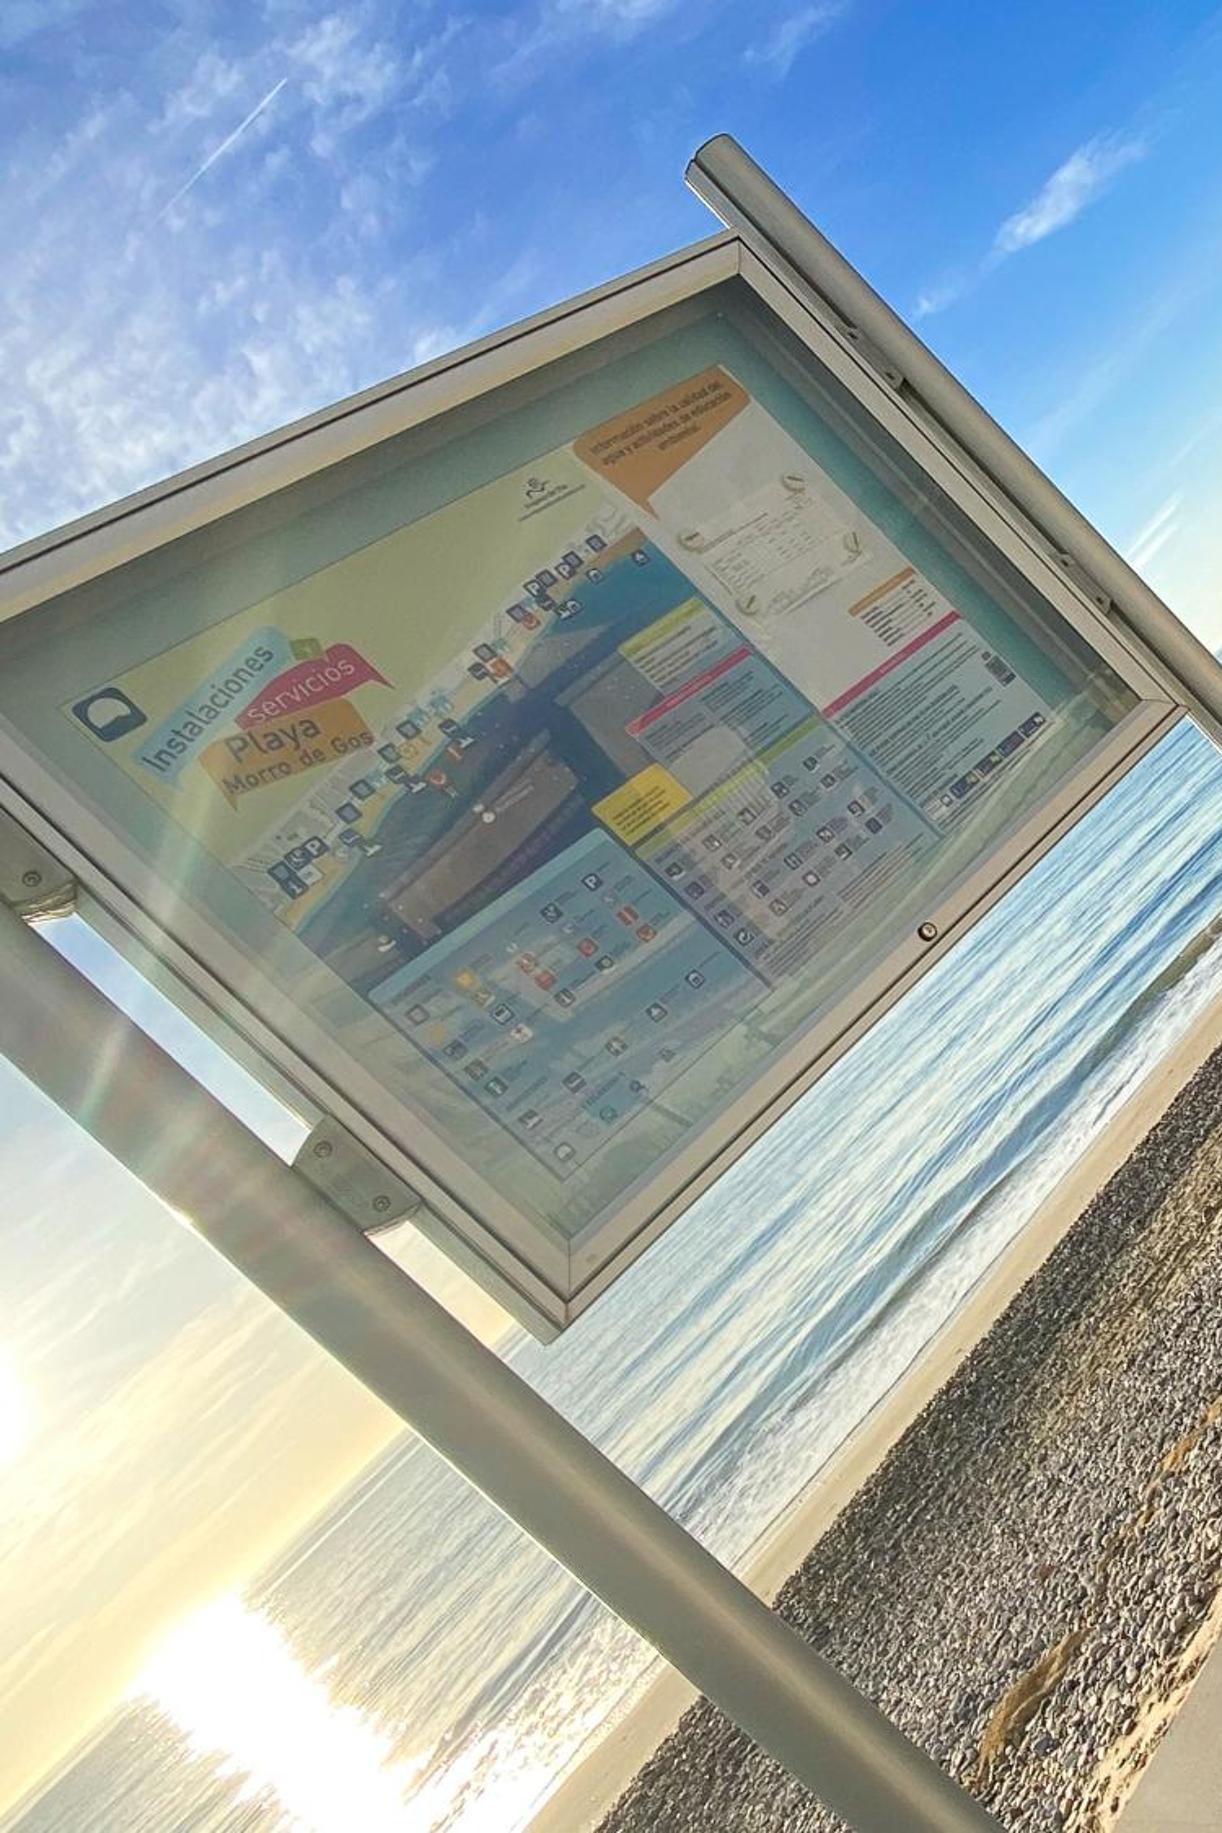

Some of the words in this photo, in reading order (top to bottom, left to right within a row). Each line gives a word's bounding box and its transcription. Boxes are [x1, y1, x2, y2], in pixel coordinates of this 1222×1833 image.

[141, 646, 275, 773] Instalaciones
[249, 658, 356, 723] servicios
[222, 760, 292, 797] Morro
[301, 746, 327, 768] de
[331, 731, 375, 754] Gos
[224, 718, 322, 764] Playa
